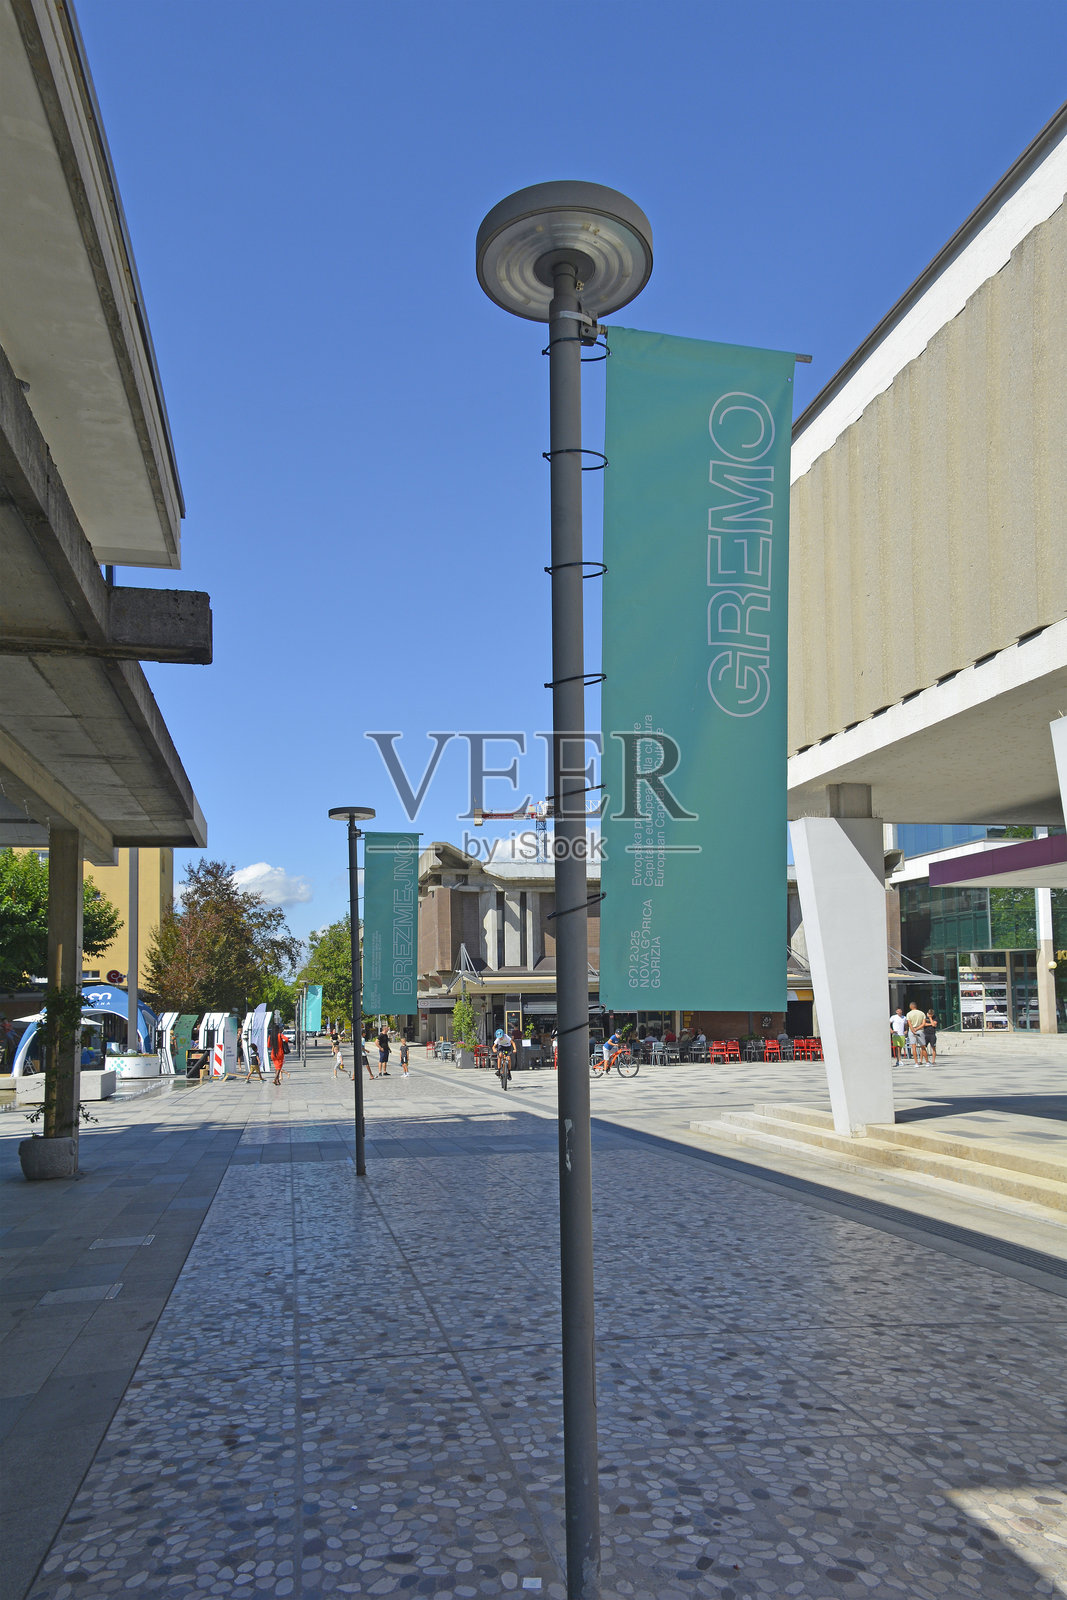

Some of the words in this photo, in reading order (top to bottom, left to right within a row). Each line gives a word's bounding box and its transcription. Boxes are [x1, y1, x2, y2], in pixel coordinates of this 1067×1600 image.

[706, 391, 776, 718] GREMO
[644, 714, 653, 754] cultura
[655, 728, 665, 767] Culture
[645, 788, 655, 834] europea
[655, 788, 666, 827] Capital
[632, 832, 643, 886] Evropska
[644, 836, 655, 887] Capitale
[654, 831, 666, 887] European
[392, 836, 414, 995] BREZMEJNO
[641, 898, 652, 950] GORICA
[630, 930, 641, 962] 2025
[640, 952, 650, 988] NOVA
[651, 936, 661, 989] GORIZIA
